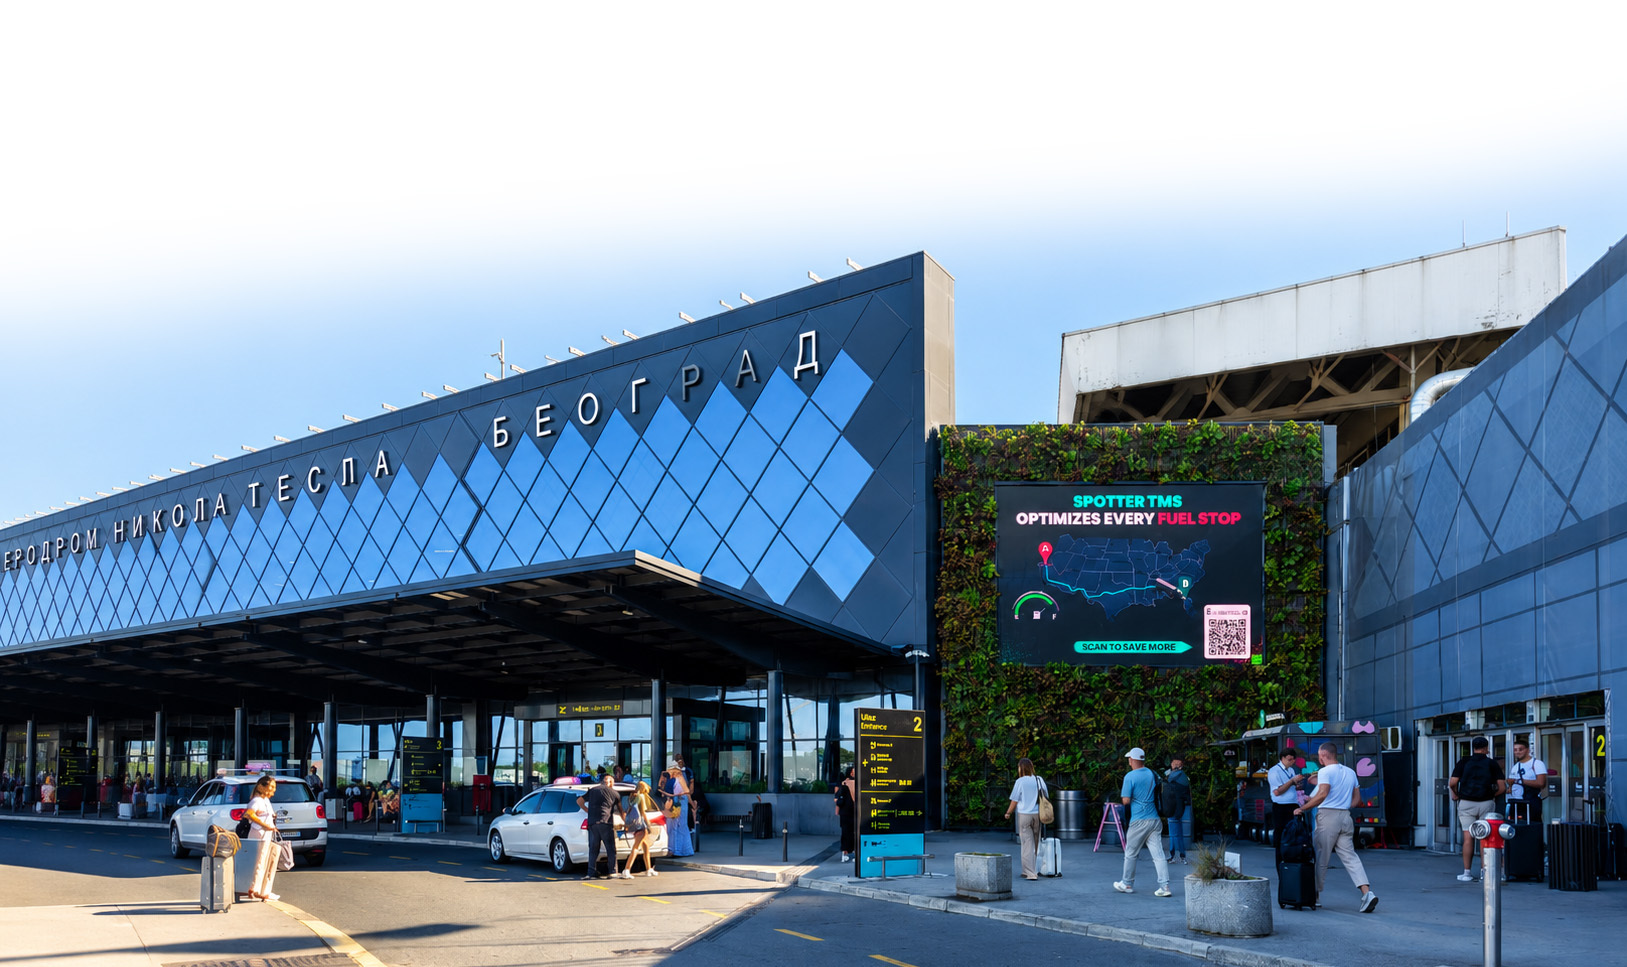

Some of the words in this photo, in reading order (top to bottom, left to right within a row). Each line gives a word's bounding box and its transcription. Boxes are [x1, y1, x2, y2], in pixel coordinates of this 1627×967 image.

[4, 527, 98, 571] ЕРОДРОМ
[114, 493, 226, 543] НИКОЛА
[248, 449, 389, 508] ТЕСЛА
[493, 330, 819, 448] БЕОГРАД
[1073, 494, 1145, 508] SPOTTER
[1147, 494, 1182, 508] TMS
[1016, 512, 1101, 525] OPTIMIZES
[1104, 512, 1155, 525] EVERY
[1158, 512, 1196, 525] FUEL
[1198, 512, 1241, 525] STOP
[1082, 643, 1108, 651] SCAN
[1109, 643, 1121, 651] TO
[1123, 643, 1147, 651] SAVE
[1148, 643, 1176, 651] MORE
[913, 716, 922, 732] 2
[1596, 734, 1606, 757] 2
